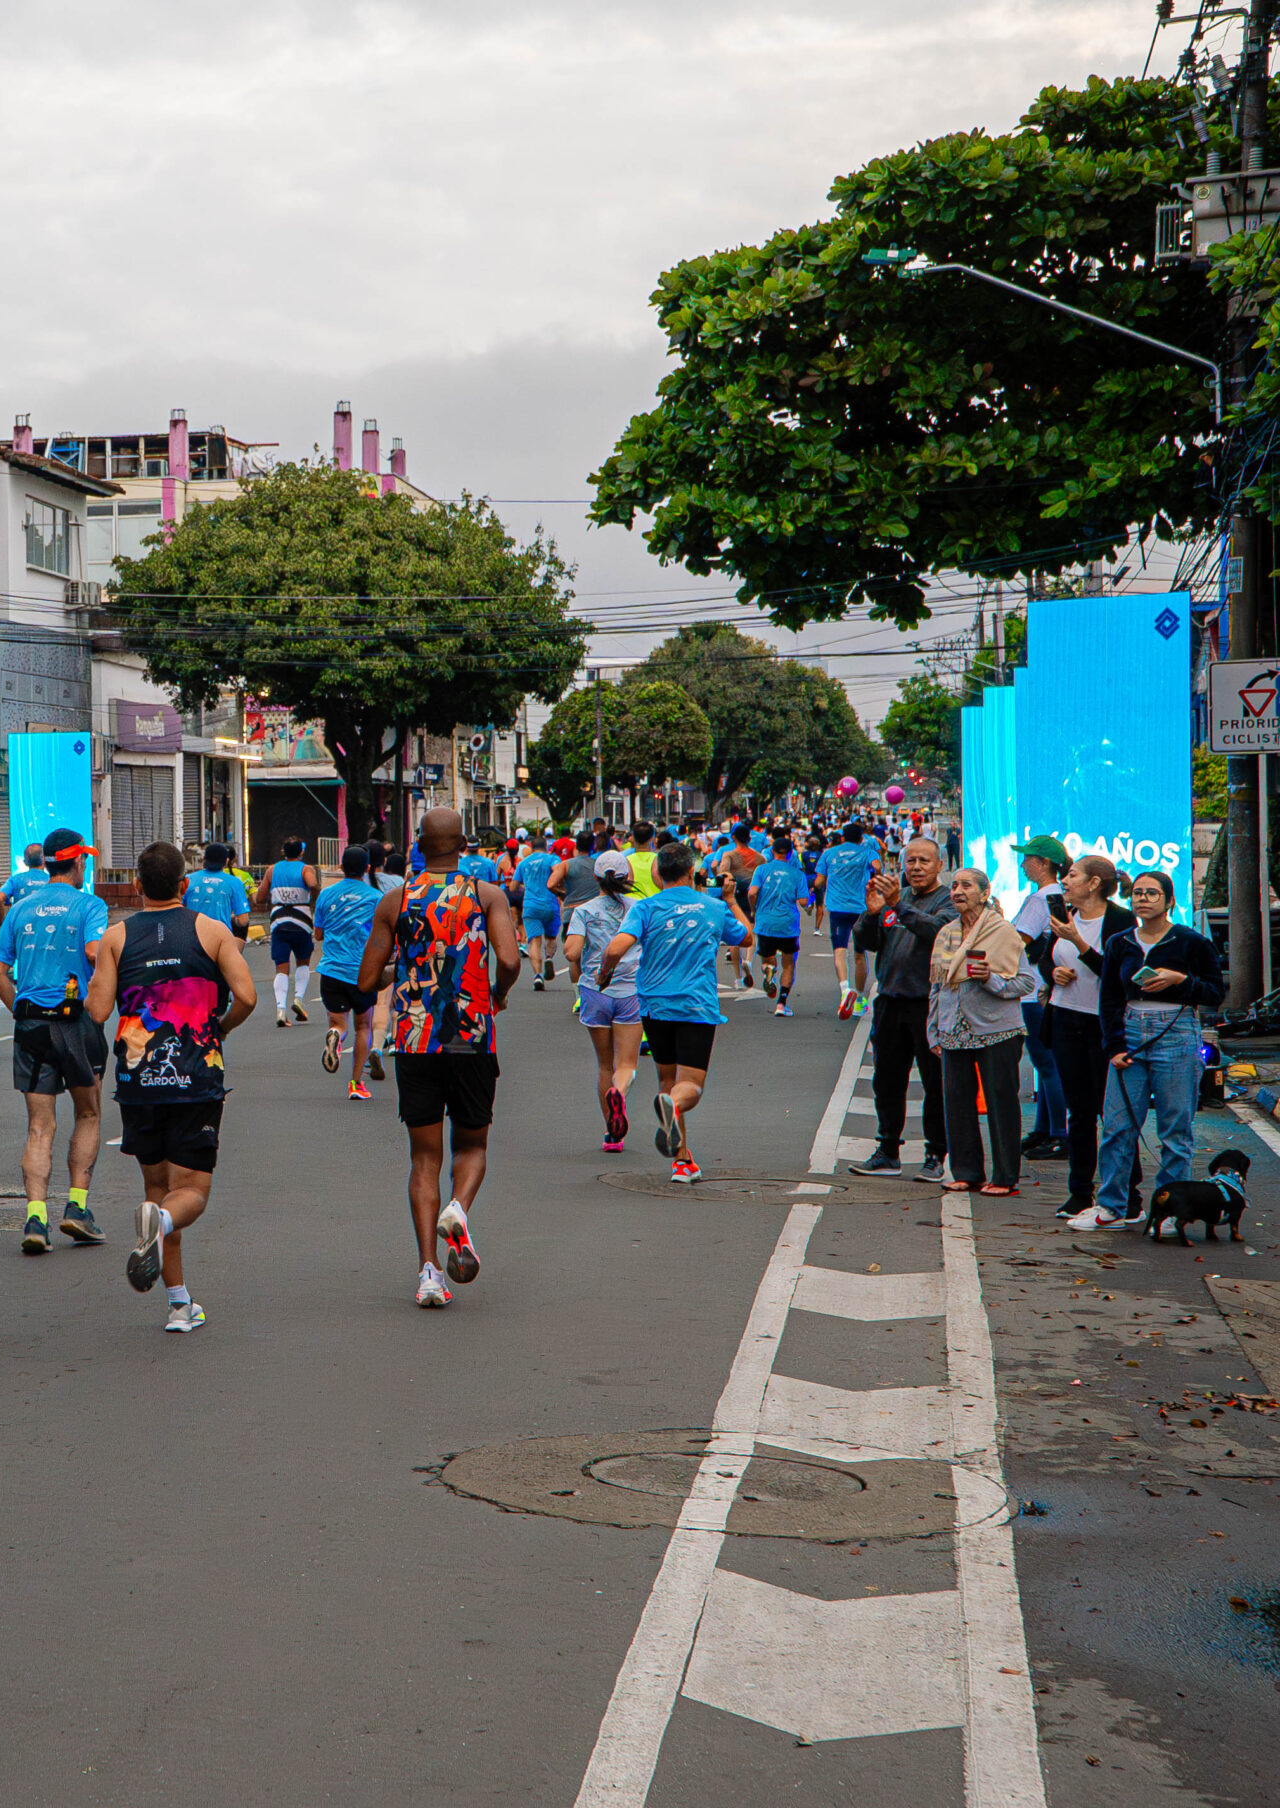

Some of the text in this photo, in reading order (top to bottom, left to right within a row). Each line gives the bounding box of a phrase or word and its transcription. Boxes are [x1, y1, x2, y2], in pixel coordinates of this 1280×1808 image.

[1092, 832, 1181, 869] AÑOS
[146, 958, 181, 968] STEVEN
[140, 1074, 193, 1087] CARDONA
